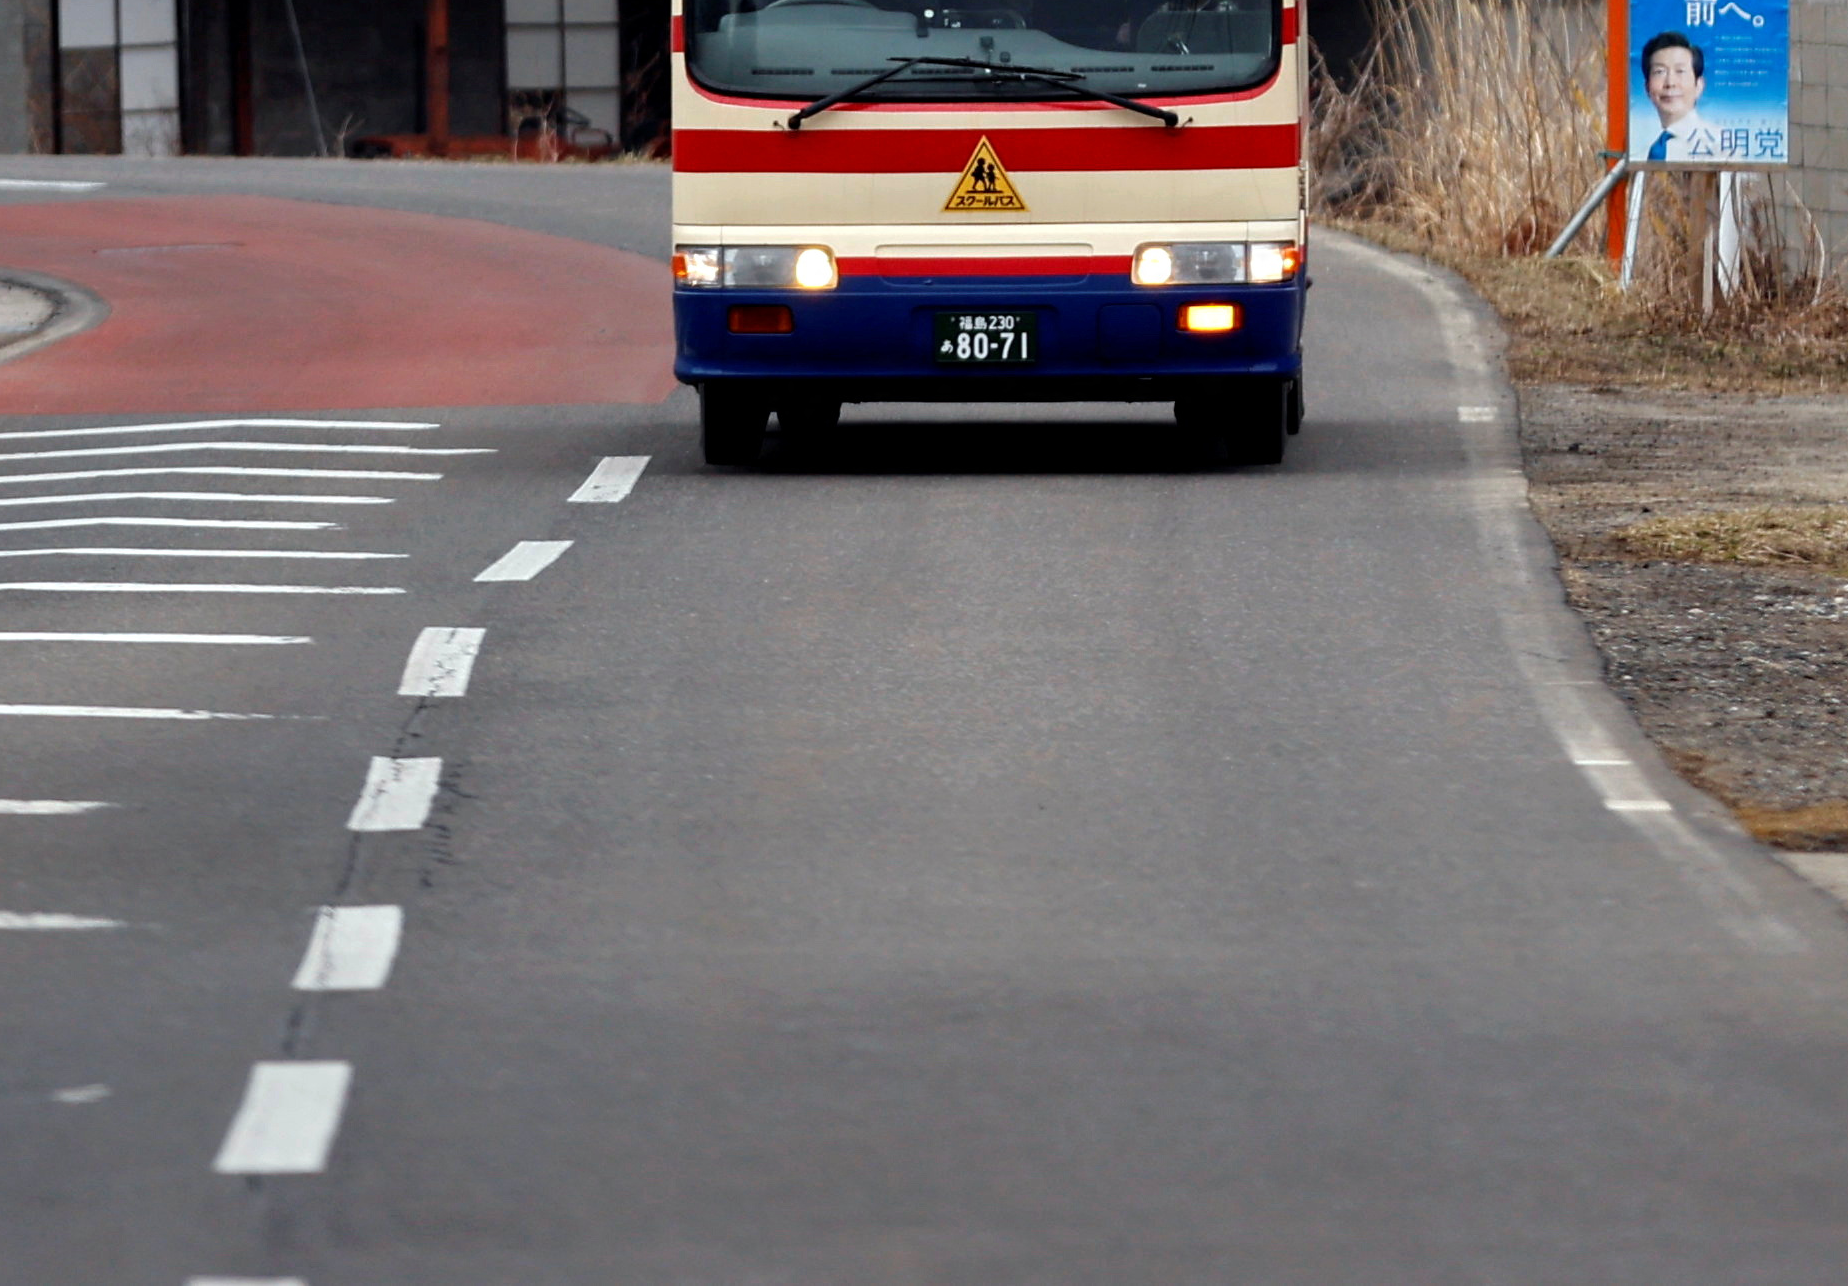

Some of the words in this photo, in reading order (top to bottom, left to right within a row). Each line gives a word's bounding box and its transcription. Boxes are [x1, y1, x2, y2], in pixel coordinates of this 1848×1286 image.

[1687, 128, 1783, 157] 公明党
[956, 195, 1015, 207] スクールバス
